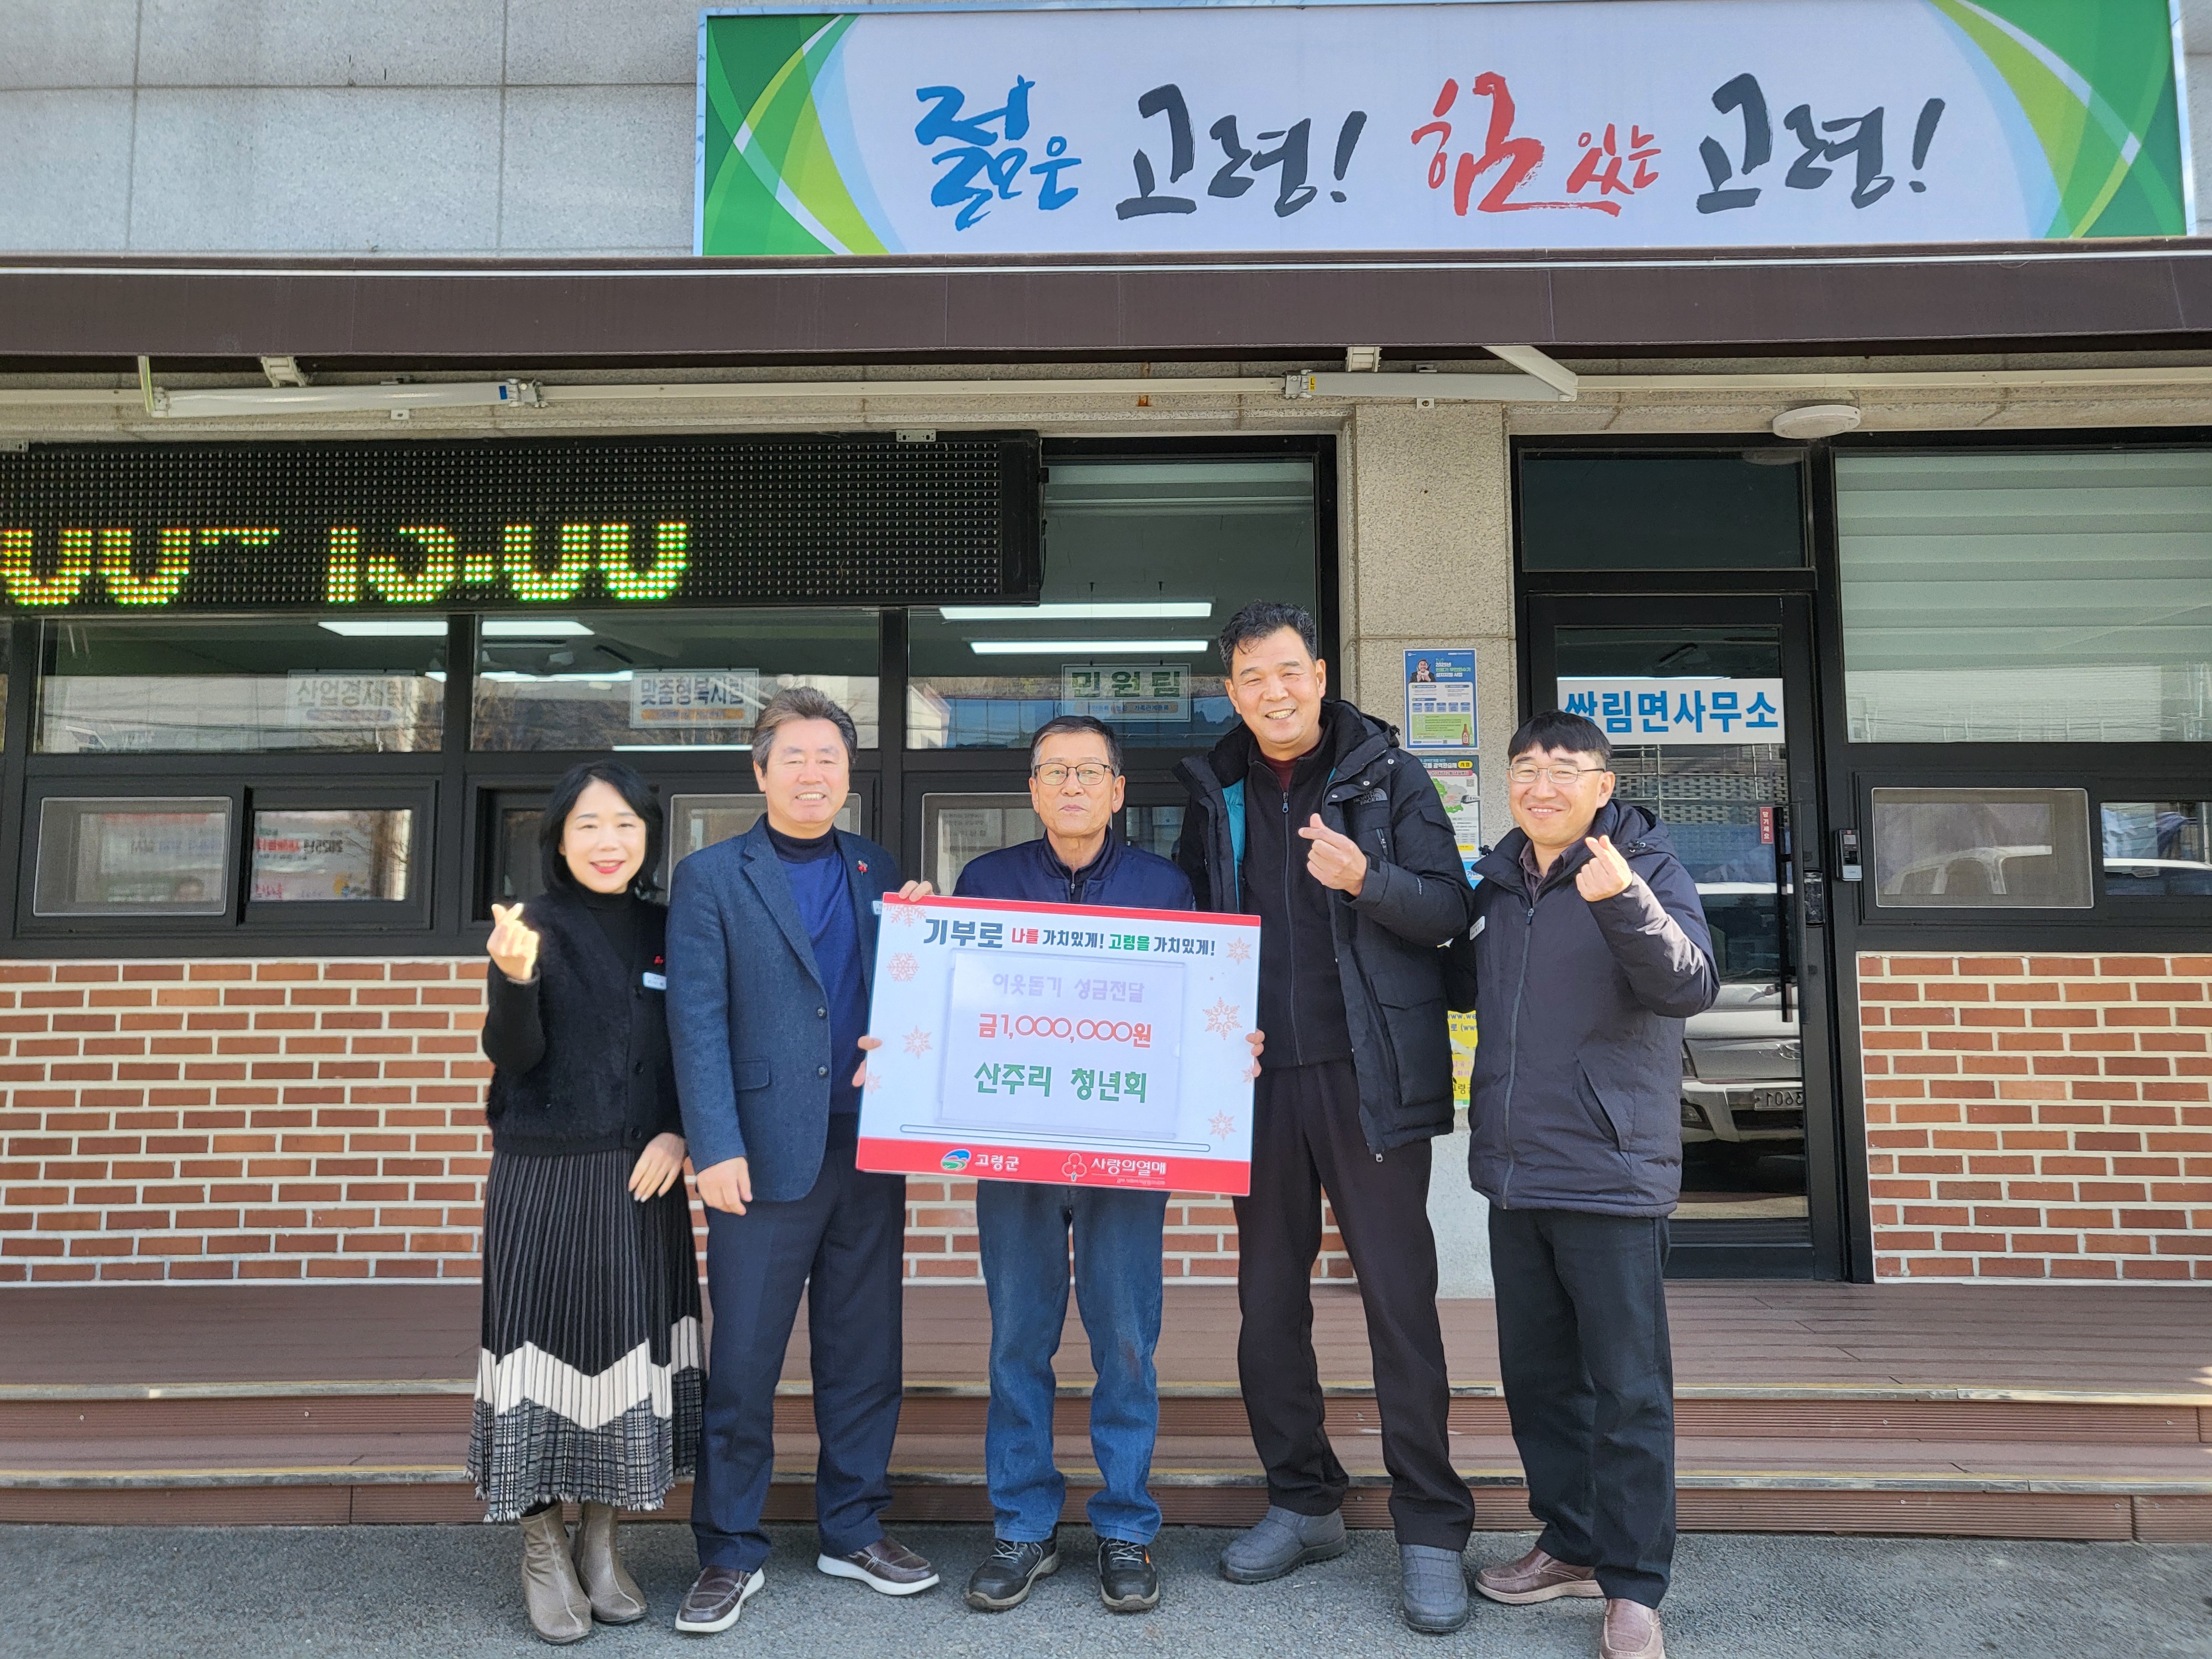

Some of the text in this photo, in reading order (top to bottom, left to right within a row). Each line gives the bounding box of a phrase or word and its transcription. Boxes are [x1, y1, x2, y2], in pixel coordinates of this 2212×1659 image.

[915, 71, 1945, 230] 젊은 고령! 힘 있는 고령!
[1072, 671, 1180, 697] 민원팀
[922, 918, 1215, 957] 기부로 나를 가치있게! 고령을 가치있게!
[992, 973, 1145, 1003] 이웃돕기 성금전달
[979, 1013, 1151, 1048] 금1,000,000원
[974, 1061, 1147, 1103] 산주리 청년회
[974, 1154, 1167, 1176] 고령군 사랑의열매
